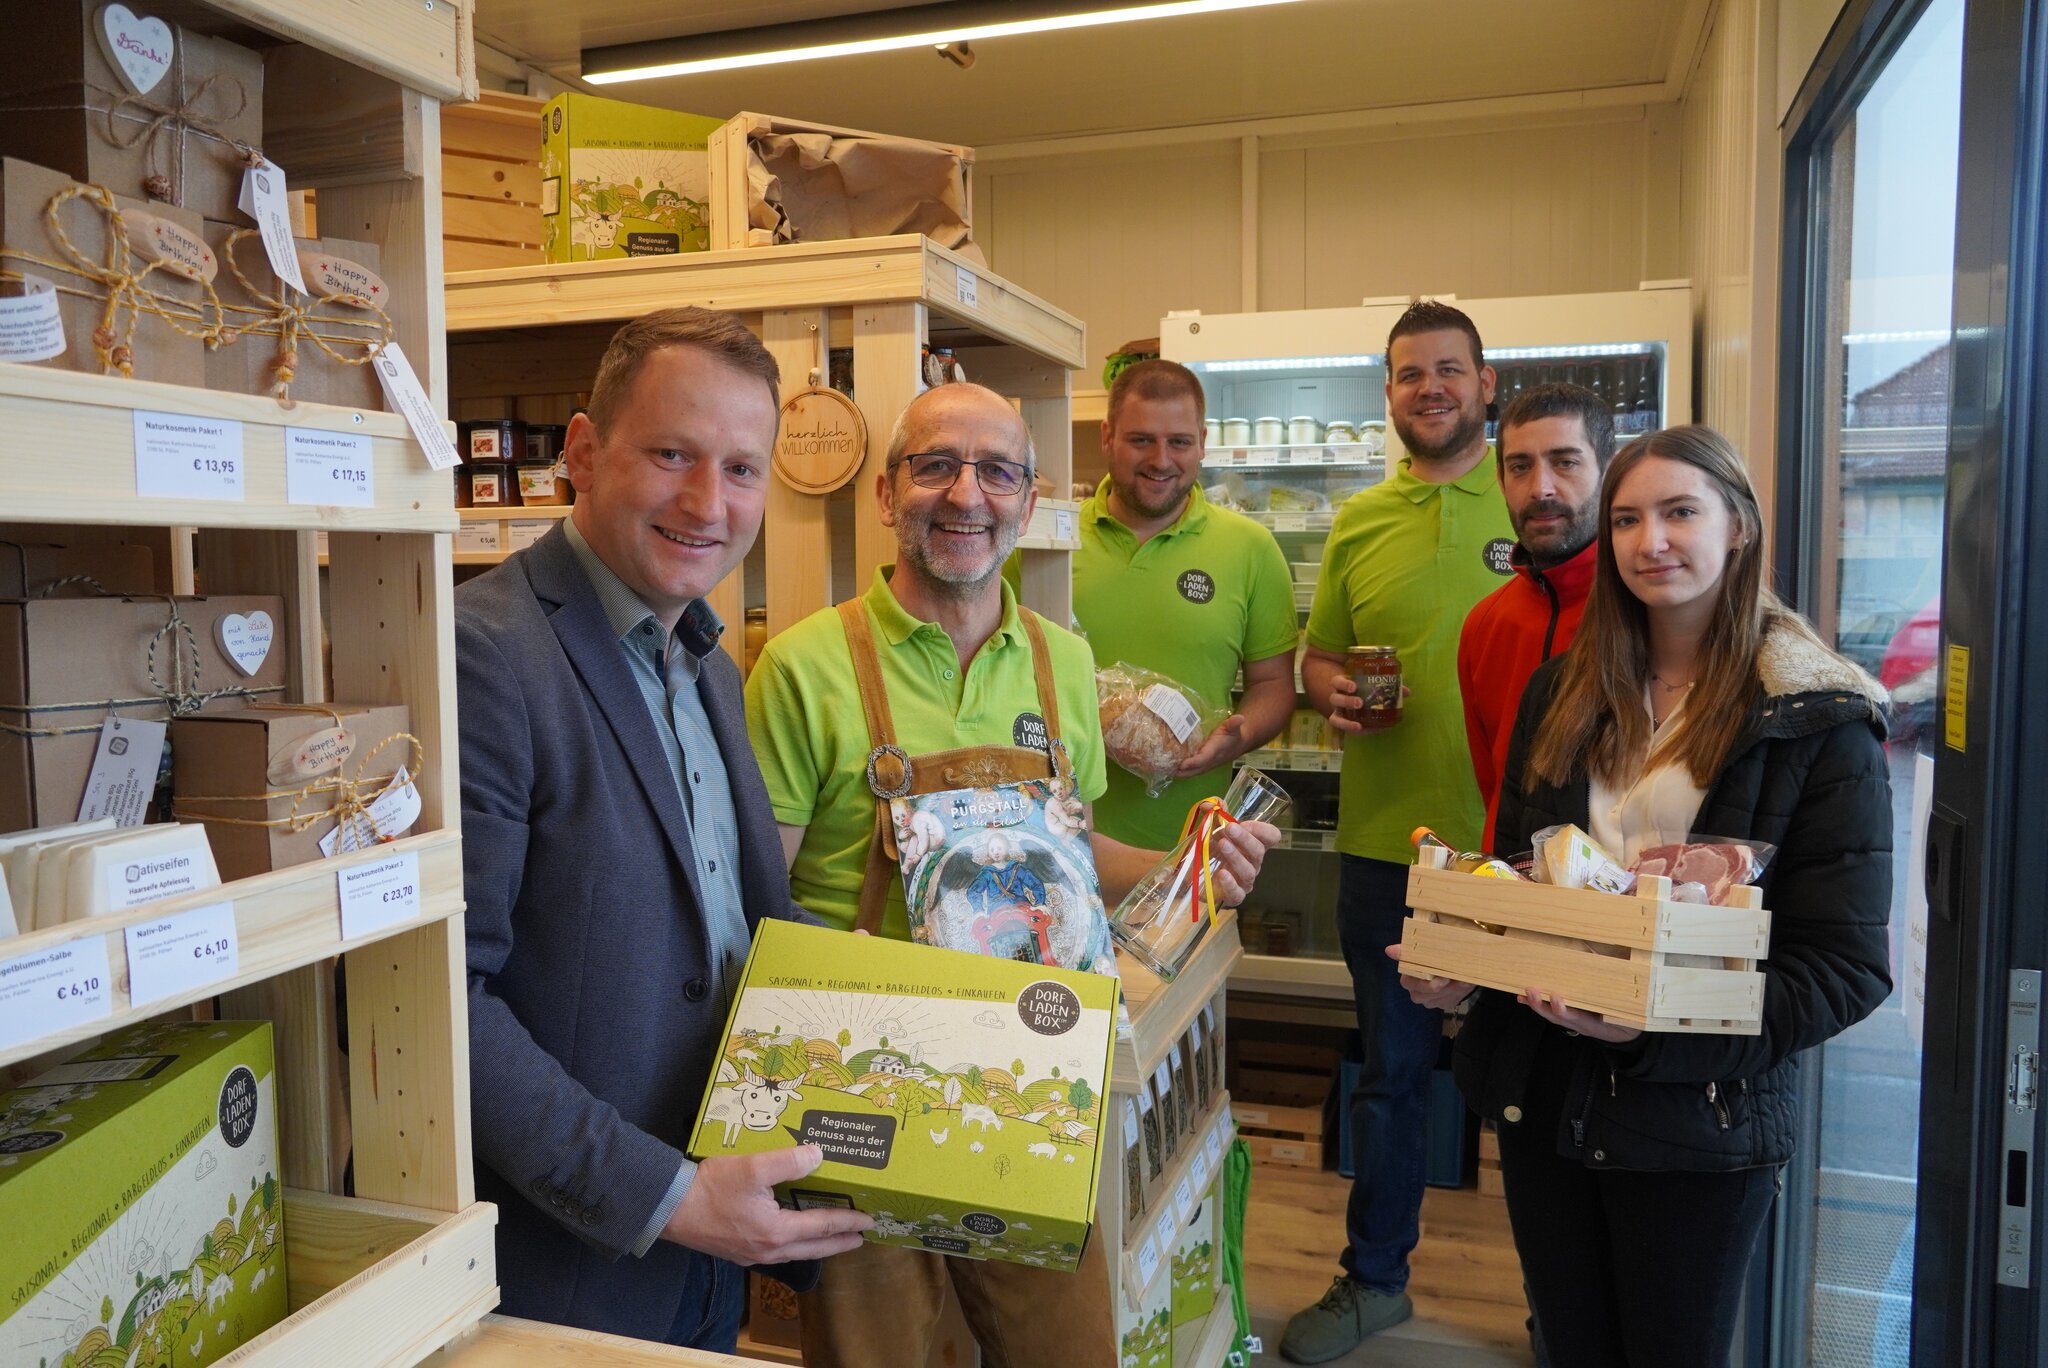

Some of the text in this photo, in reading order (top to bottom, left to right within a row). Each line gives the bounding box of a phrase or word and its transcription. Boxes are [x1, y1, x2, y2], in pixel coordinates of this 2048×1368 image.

[116, 32, 168, 65] Danke!
[166, 226, 199, 256] Happy
[631, 243, 653, 251] Genuss
[637, 236, 669, 244] Regionaler
[159, 239, 203, 272] Birthday
[333, 262, 368, 286] Happy
[324, 274, 372, 301] Birthday
[146, 421, 223, 436] Naturkosmetik Paket 1
[786, 420, 848, 439] herzlich
[294, 436, 335, 447] Naturkosmetik
[337, 440, 352, 448] Paket
[193, 459, 235, 474] € 13,95
[332, 469, 366, 482] € 17,15
[1493, 542, 1513, 553] DORF
[1490, 551, 1511, 562] LADE
[1495, 560, 1514, 571] BOX
[1183, 580, 1209, 593] LADEN
[1187, 573, 1207, 583] DORF
[1187, 589, 1205, 601] BOX
[1367, 676, 1397, 684] HONIG
[1022, 720, 1046, 735] DORF
[309, 737, 336, 753] Happy
[309, 745, 350, 769] Birthday
[111, 795, 120, 818] osmarin
[950, 799, 1027, 818] PURGSTALL
[346, 866, 384, 882] Naturkosmetik
[385, 862, 399, 871] Paket
[129, 876, 191, 896] Haarseife Apfelessig
[383, 892, 389, 903] €
[391, 885, 413, 901] 23,70
[136, 923, 172, 938] Nativ-Deo
[194, 939, 228, 958] € 6,10
[57, 977, 99, 1000] € 6,10
[768, 976, 1006, 1000] SAISONAL REGIONAL BARGELDLOS EINKAUFEN
[1035, 989, 1067, 1004] DORF
[1029, 1000, 1069, 1018] LADEN
[1034, 1013, 1061, 1029] BOX
[227, 1077, 247, 1104] DORF
[226, 1093, 252, 1123] LADEN
[232, 1114, 250, 1138] BOX
[821, 1116, 876, 1132] Regionaler
[807, 1127, 886, 1146] Genuss aus der
[11, 1115, 211, 1307] SAISONAL REGIONAL BARGELDLOS EINKAUFEN
[973, 1215, 995, 1223] DORF
[969, 1220, 999, 1230] LADEN
